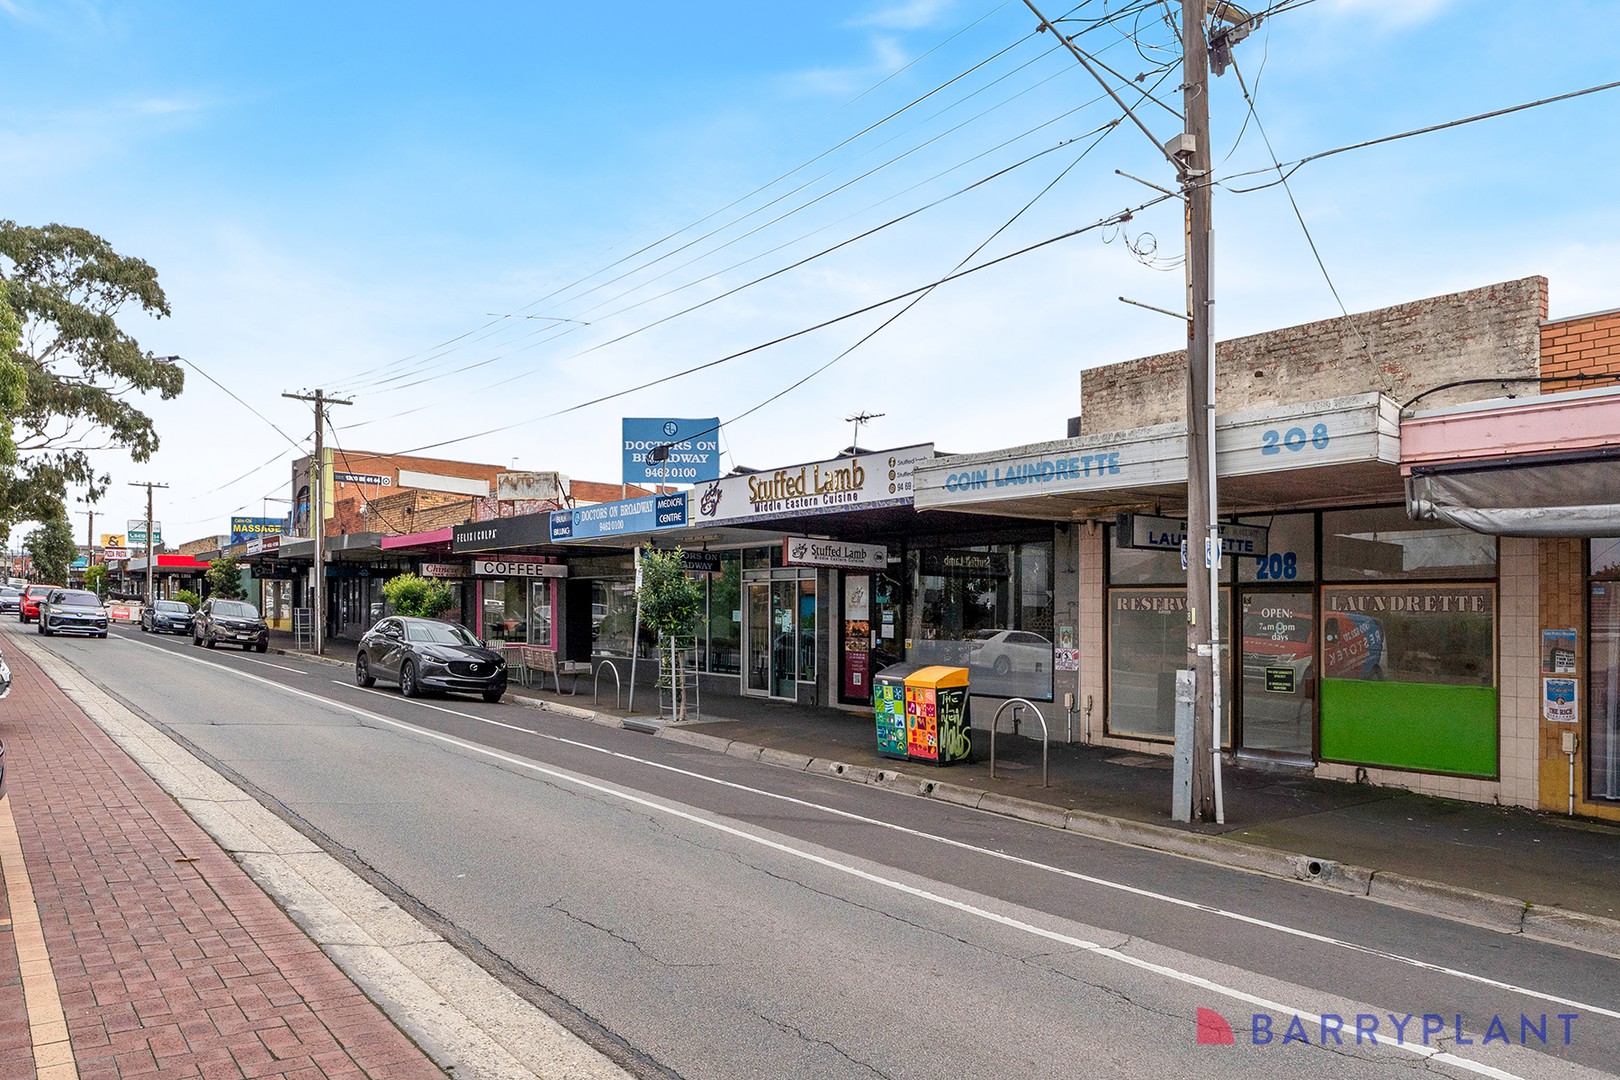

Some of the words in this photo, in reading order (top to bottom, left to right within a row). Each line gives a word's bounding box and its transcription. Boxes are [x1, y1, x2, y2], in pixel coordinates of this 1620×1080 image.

[625, 440, 692, 451] DOCTORS
[696, 441, 717, 451] ON
[1261, 423, 1329, 455] 208
[645, 468, 670, 478] 9462
[670, 468, 697, 478] 0100
[945, 468, 989, 493] COIN
[994, 451, 1121, 487] LAUNDRETTE
[749, 467, 805, 502] Stuffed
[814, 458, 865, 492] Lamb
[657, 497, 684, 509] MEDICAL
[754, 500, 781, 513] Middle
[785, 496, 819, 509] Eastern
[822, 491, 858, 504] Cuisine
[581, 507, 608, 522] DOCTORS
[609, 505, 618, 518] ON
[620, 500, 654, 516] BROADWAY
[659, 512, 682, 523] CENTRE
[233, 523, 282, 534] MASSAGE
[811, 543, 841, 558] Stuffed
[844, 546, 867, 559] Lamb
[483, 561, 544, 576] COFFEE
[1255, 551, 1298, 580] 208
[1331, 595, 1486, 613] LAUNDRETTE
[1261, 607, 1293, 619] OPEN:
[1271, 632, 1289, 642] days
